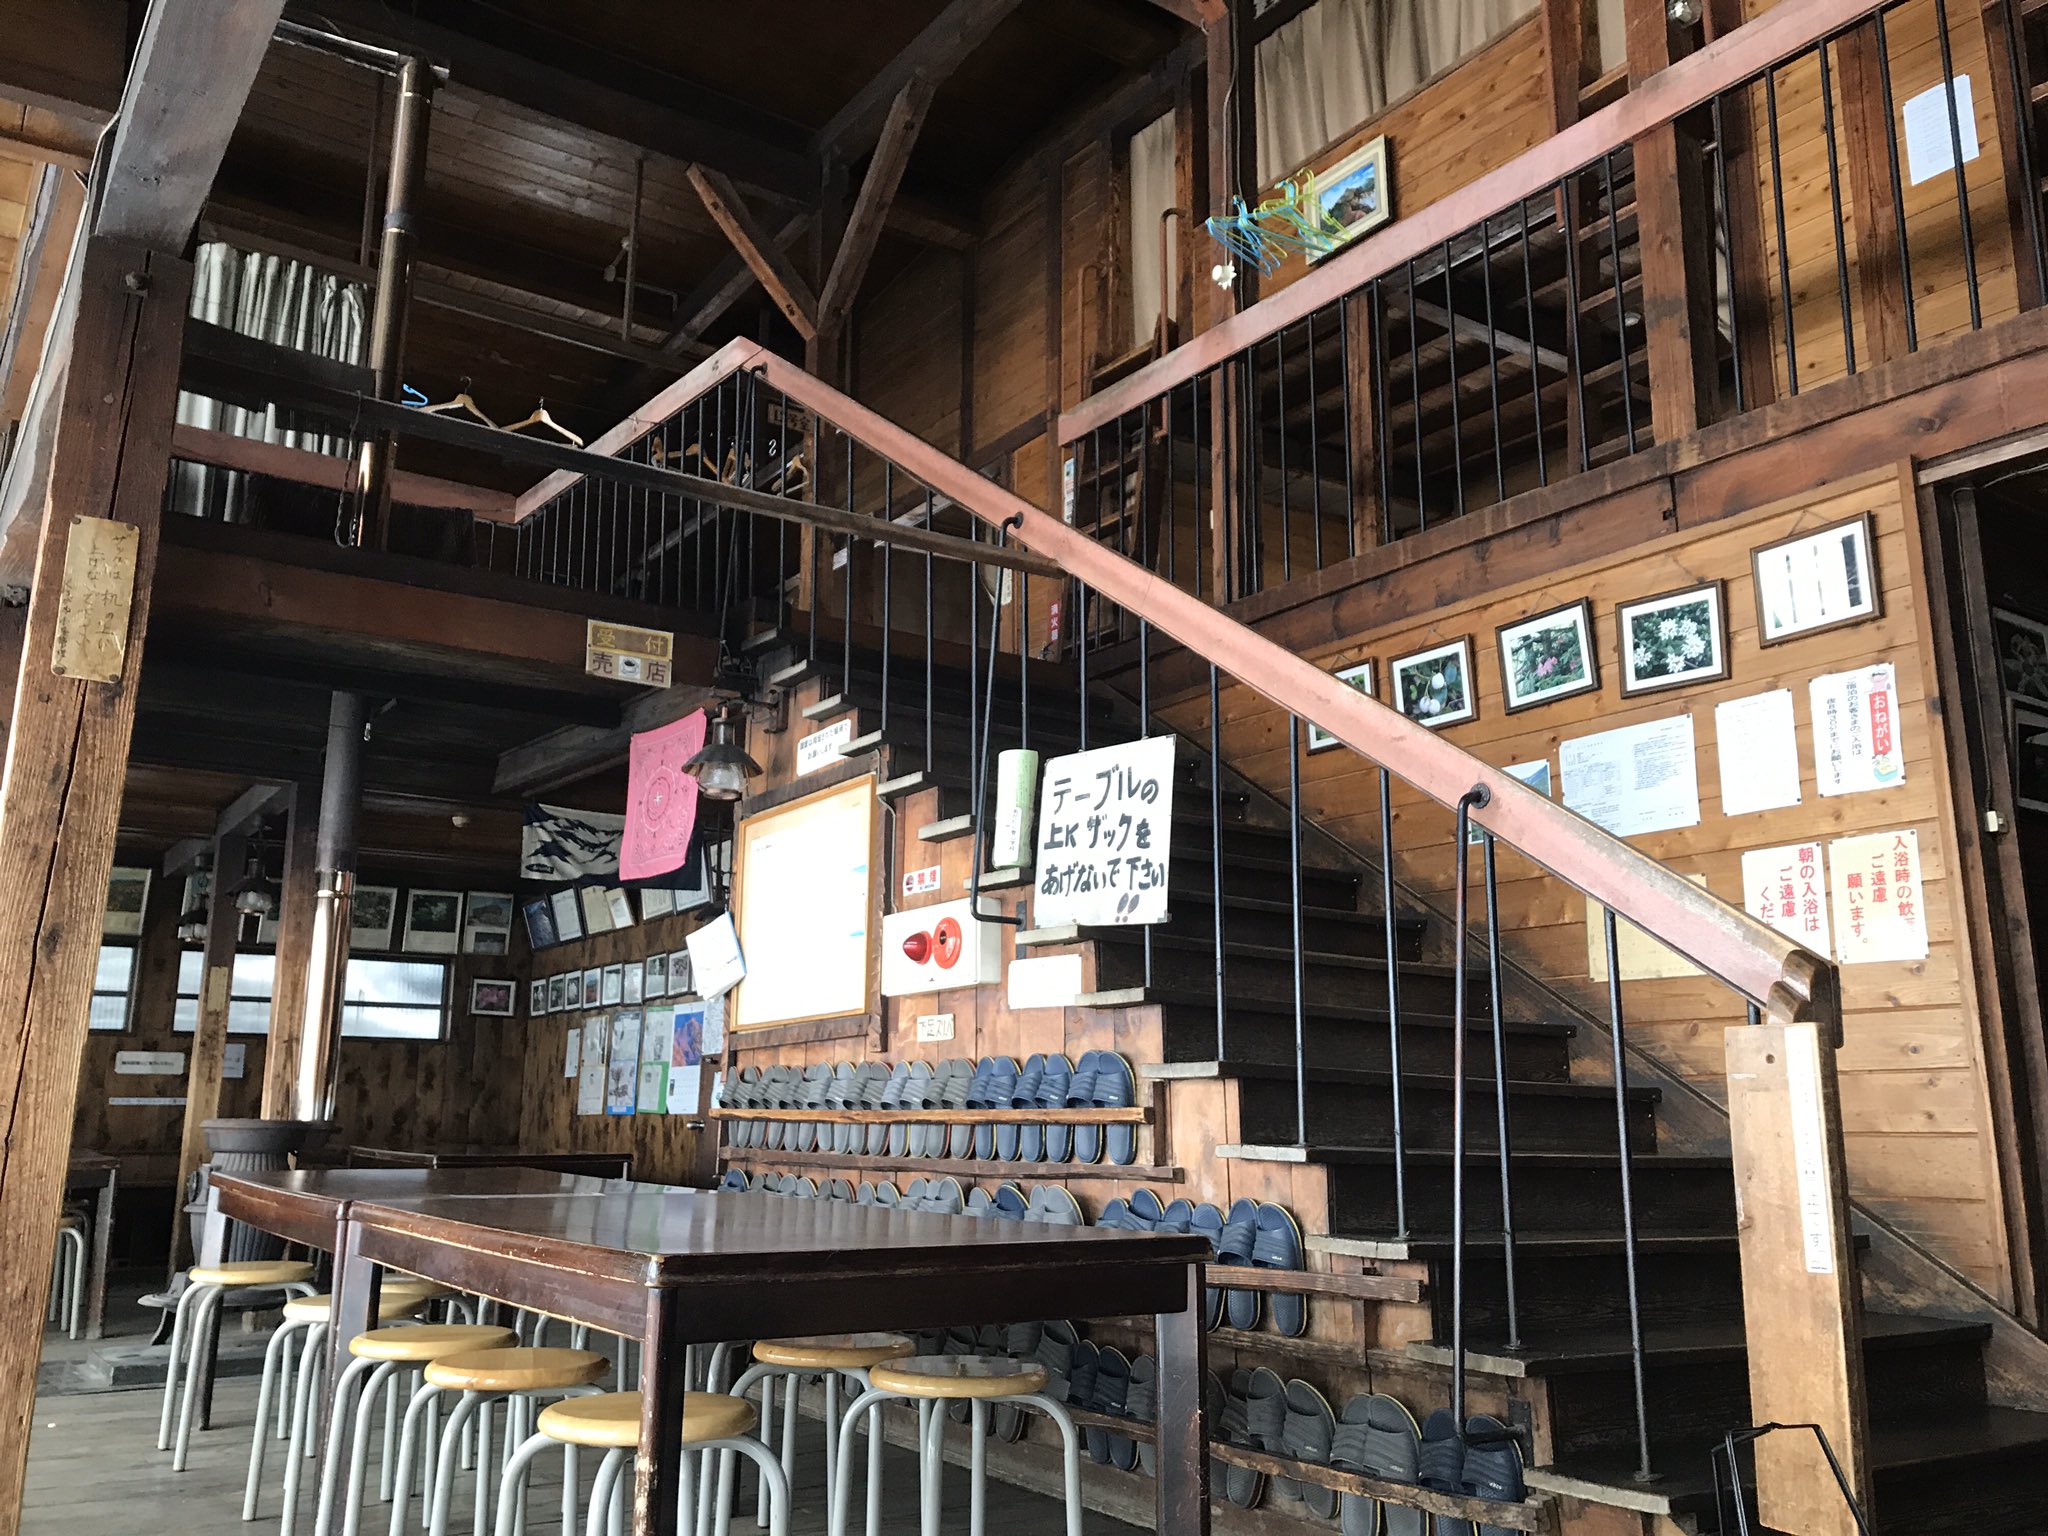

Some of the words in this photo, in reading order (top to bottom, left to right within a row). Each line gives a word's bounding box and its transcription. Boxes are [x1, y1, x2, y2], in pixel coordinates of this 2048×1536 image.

[597, 628, 664, 654] 受付
[592, 652, 667, 683] 売店
[1873, 695, 1889, 752] おねがい
[1053, 763, 1160, 815] テーブルの
[1041, 856, 1165, 897] あげないで下さい
[1779, 866, 1797, 918] ご遠慮
[1798, 847, 1821, 932] 朝の入浴は
[1870, 853, 1888, 903] ご遠慮
